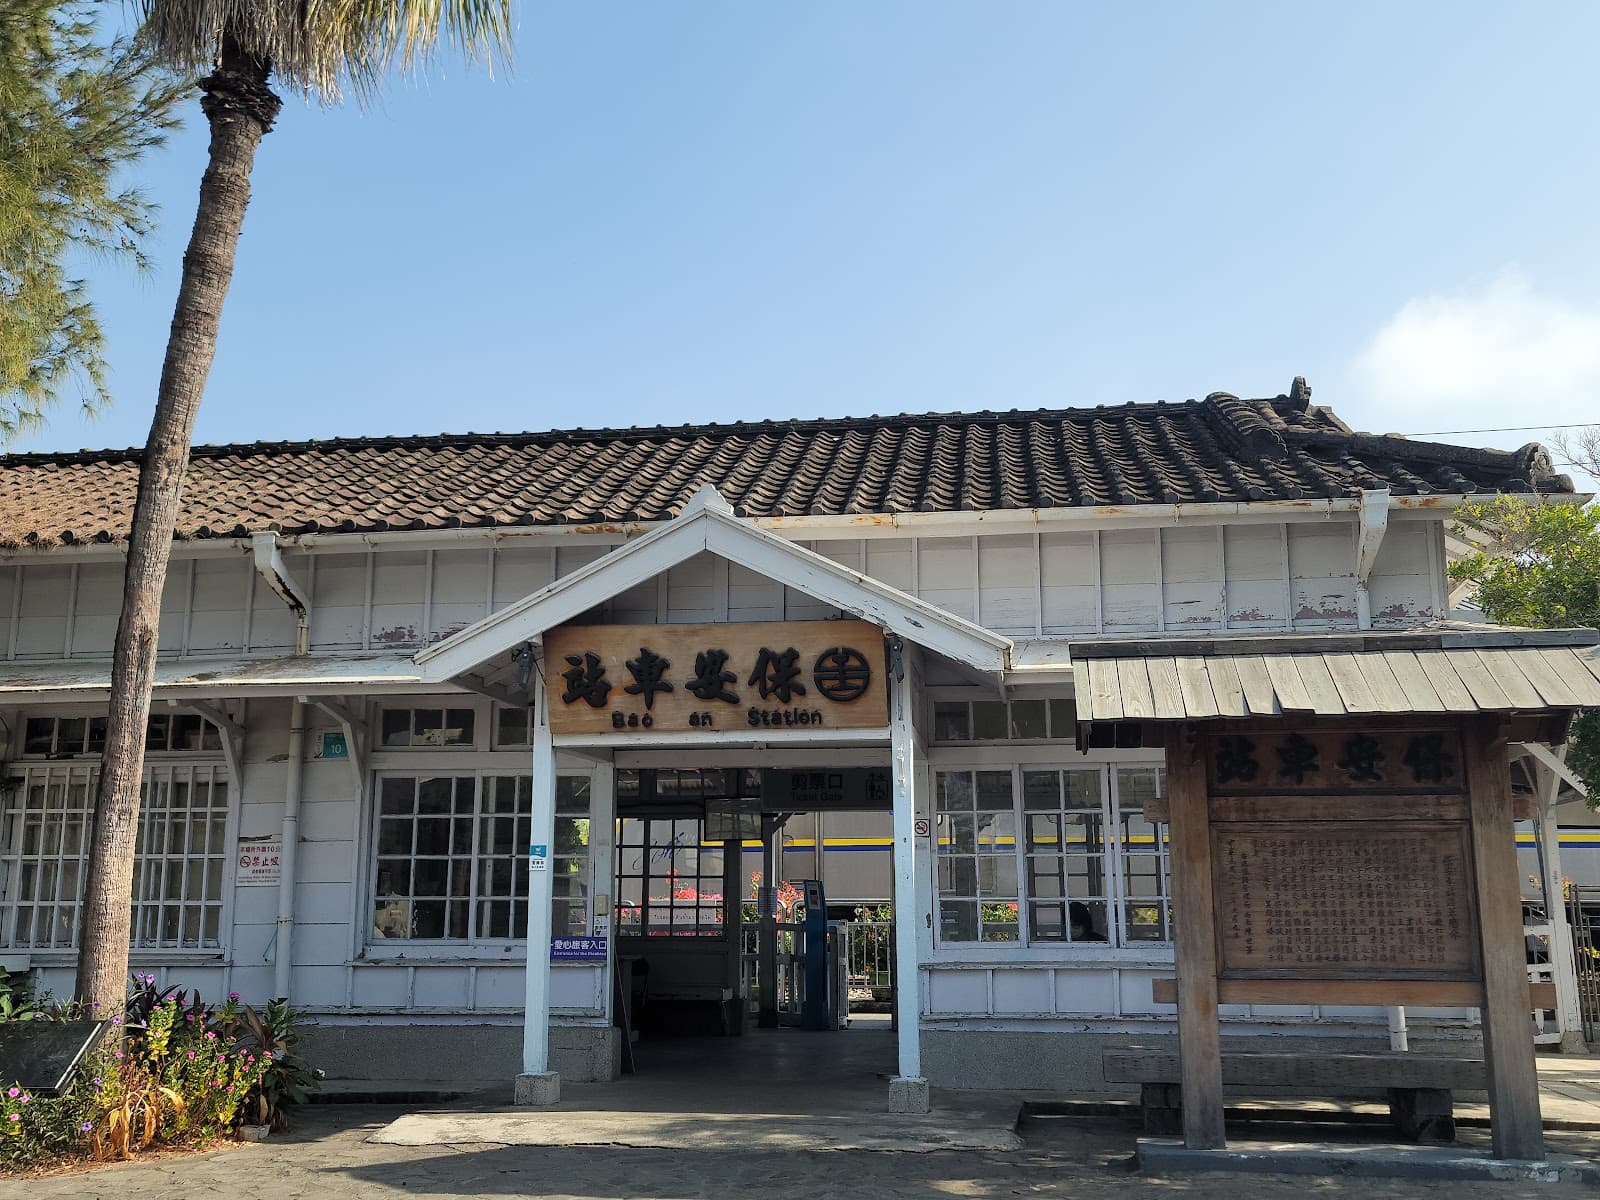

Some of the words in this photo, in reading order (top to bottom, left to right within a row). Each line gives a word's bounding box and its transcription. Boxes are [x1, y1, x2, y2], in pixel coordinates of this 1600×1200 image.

[612, 710, 653, 728] Bao
[689, 712, 712, 727] an
[747, 707, 822, 726] Station
[331, 744, 342, 754] 10
[554, 939, 607, 950] 愛心旅客入口
